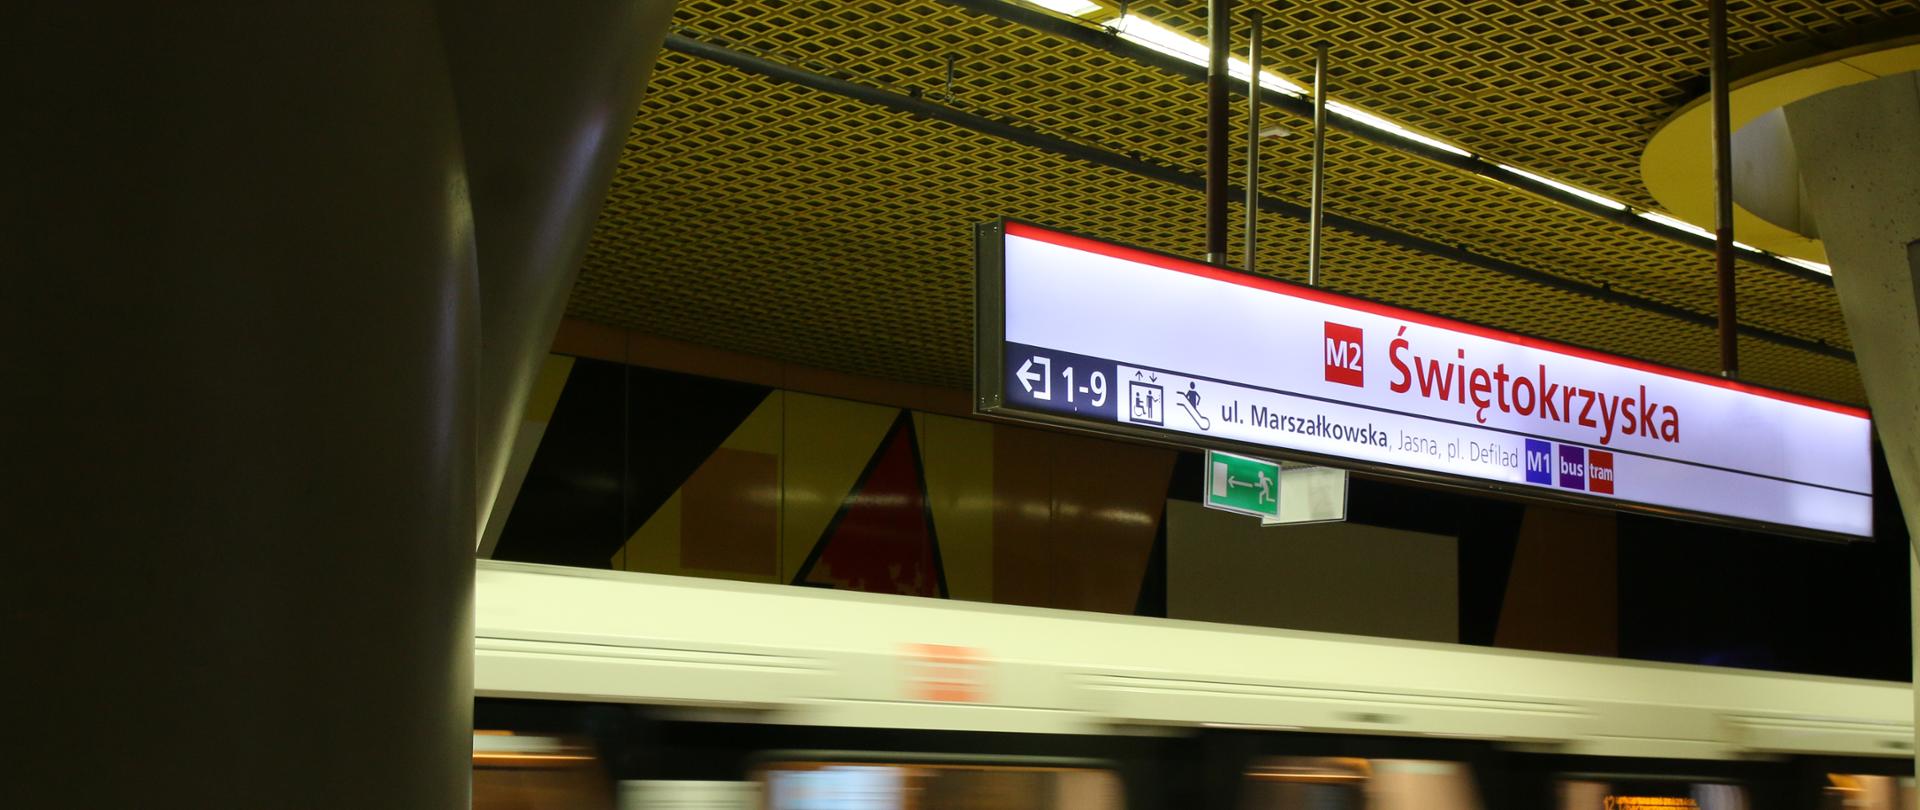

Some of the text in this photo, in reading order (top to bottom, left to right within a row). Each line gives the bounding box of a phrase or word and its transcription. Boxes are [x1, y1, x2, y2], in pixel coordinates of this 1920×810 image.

[1062, 366, 1107, 407] 1-9
[1326, 326, 1680, 444] M2 Świętokrzyska
[1221, 400, 1613, 481] ul. Marszałkowska, Jasna, pl. Defilad M1 bus tram
